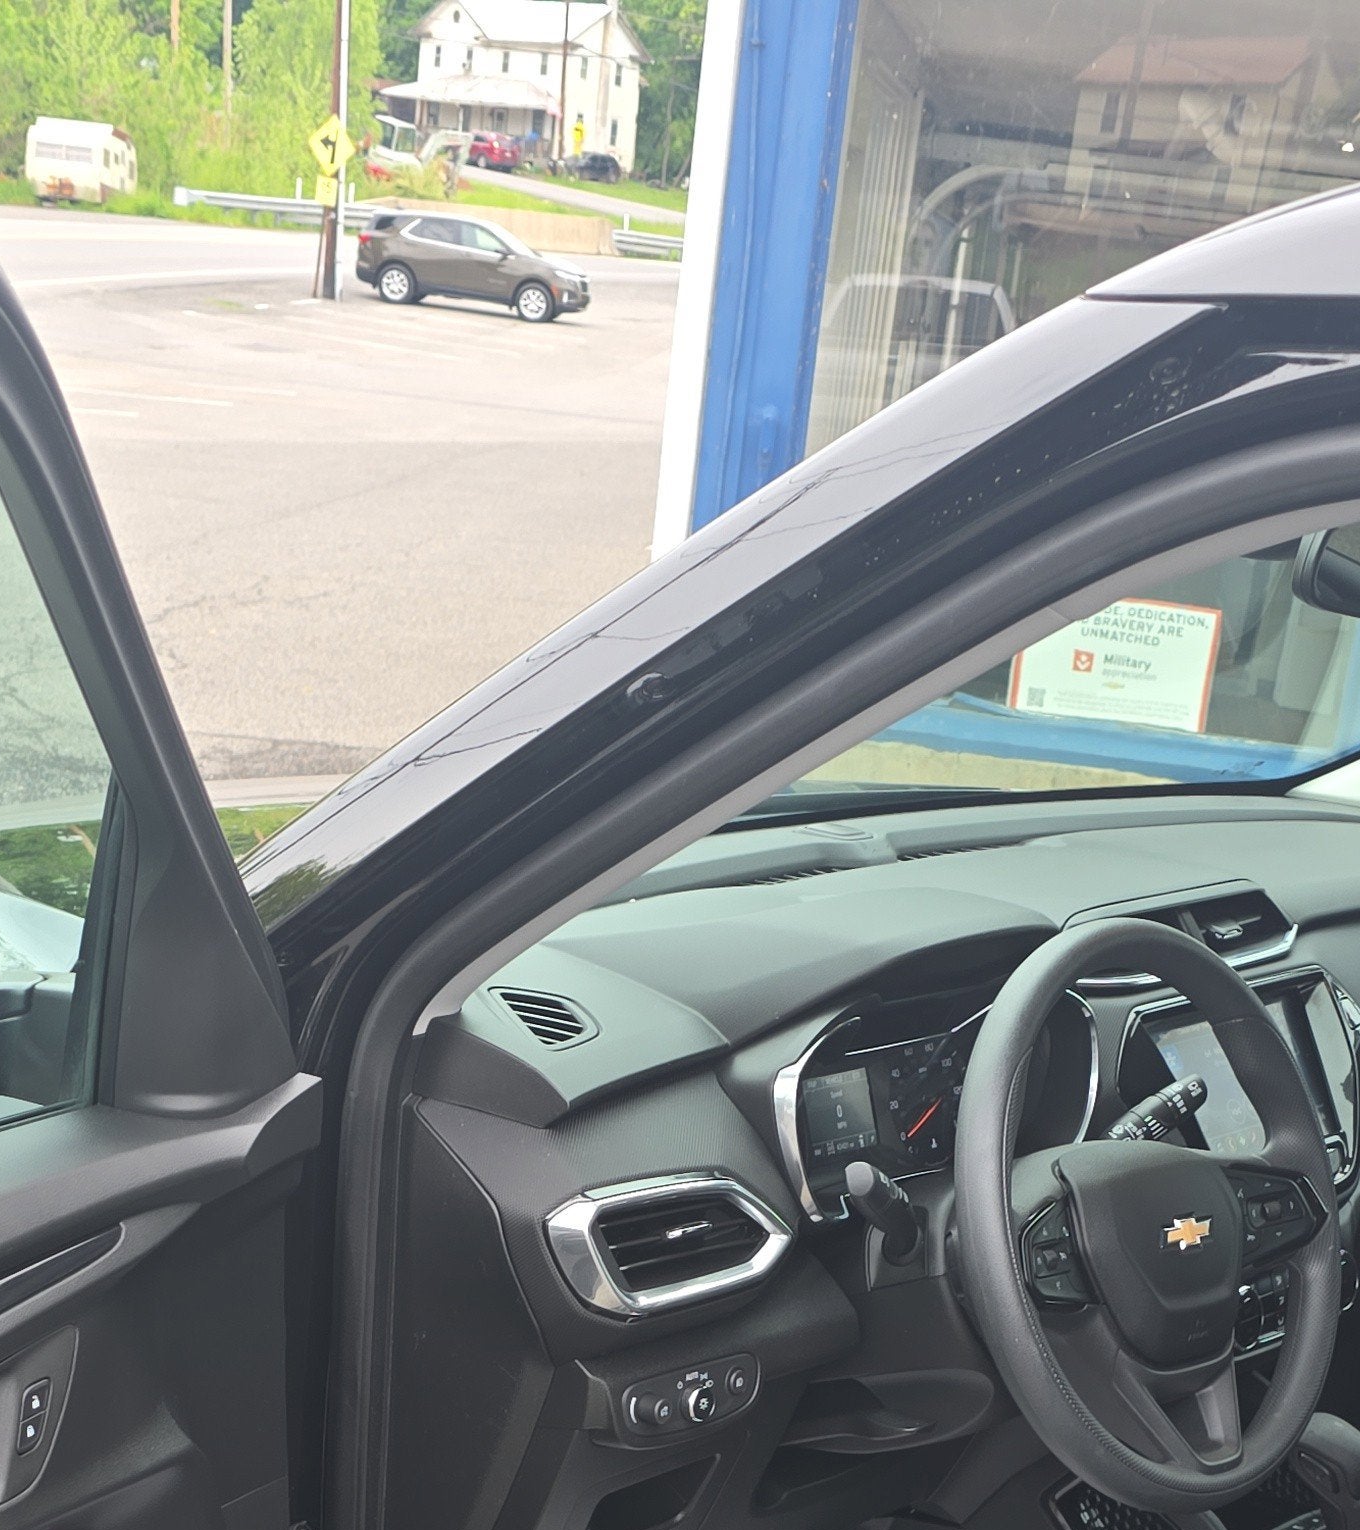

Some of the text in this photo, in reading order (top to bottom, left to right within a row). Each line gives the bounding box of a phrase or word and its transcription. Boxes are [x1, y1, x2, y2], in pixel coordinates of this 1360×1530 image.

[1093, 615, 1154, 632] BRAVERY
[1157, 624, 1184, 637] ARE
[1128, 607, 1209, 629] DEDICATION,
[1081, 627, 1161, 646] UNMATCHED
[1103, 654, 1152, 672] Military
[889, 1099, 899, 1110] 20
